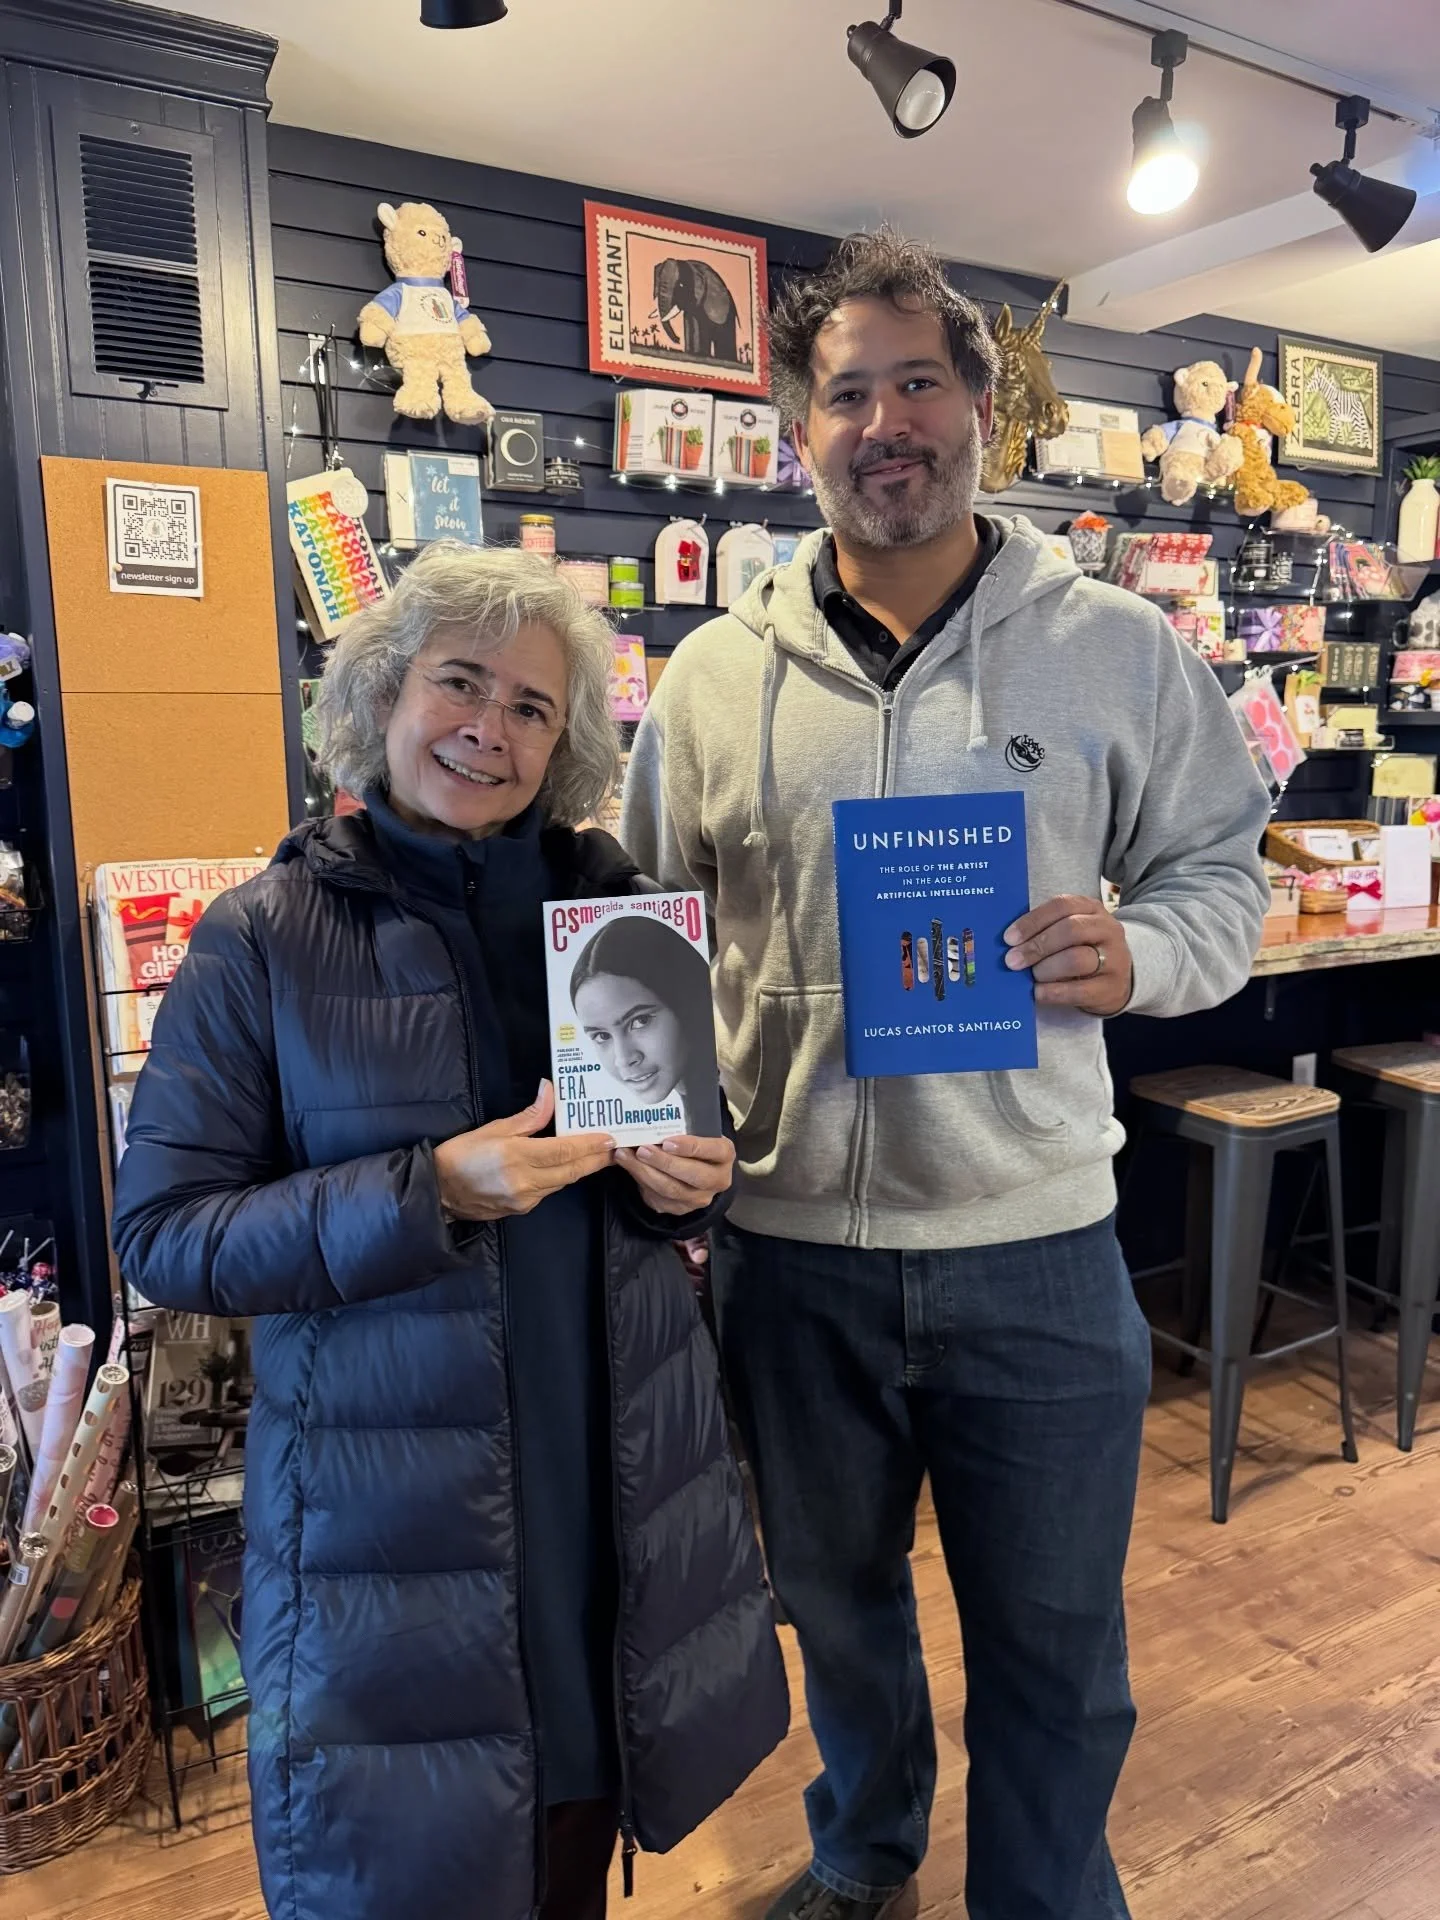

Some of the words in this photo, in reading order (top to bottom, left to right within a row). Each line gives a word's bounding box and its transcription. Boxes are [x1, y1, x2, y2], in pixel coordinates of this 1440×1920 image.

[606, 229, 624, 351] ELEPHANT
[1290, 357, 1301, 448] ZEBRA
[431, 475, 450, 494] let
[434, 514, 466, 530] snow
[288, 500, 340, 622] KATONAH
[299, 497, 351, 616] KATONAH
[120, 572, 164, 582] newsletter
[164, 573, 182, 585] sign
[183, 576, 195, 585] up
[853, 825, 1012, 851] UNFINISHED
[879, 866, 896, 874] THE
[898, 865, 920, 873] ROLE
[923, 864, 935, 872] OF
[937, 863, 955, 871] THE
[957, 861, 989, 870] ARTIST
[902, 878, 913, 886] IN
[915, 877, 932, 885] THE
[934, 876, 952, 884] AGE
[955, 875, 967, 883] OF
[876, 890, 928, 900] ARTIFICIAL
[930, 886, 995, 897] INTELLIGENCE
[551, 900, 624, 952] esmeralda
[630, 896, 702, 942] santiago
[152, 944, 189, 962] HO
[864, 1026, 902, 1038] LUCAS
[905, 1023, 954, 1036] CANTOR
[958, 1020, 1022, 1033] SANTIAGO
[558, 1063, 601, 1074] CUANDO
[558, 1075, 587, 1101] ERA
[159, 1379, 207, 1409] 129
